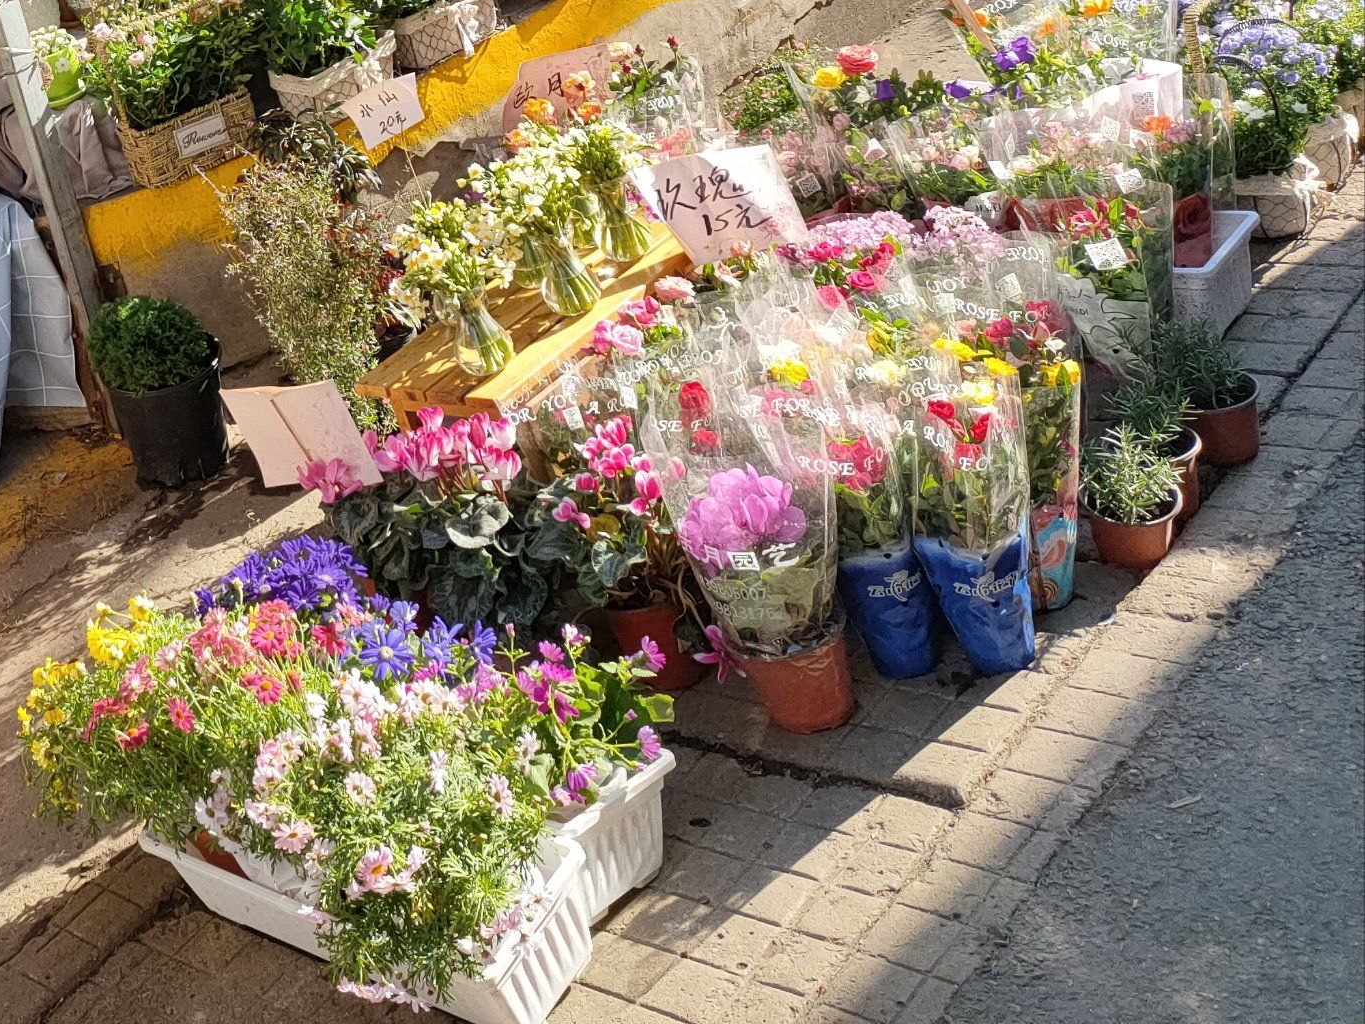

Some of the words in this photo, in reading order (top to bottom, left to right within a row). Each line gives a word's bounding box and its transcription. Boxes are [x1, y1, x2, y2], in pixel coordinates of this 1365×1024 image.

[360, 90, 399, 119] 水仙
[379, 112, 408, 134] 20元
[182, 126, 229, 149] Flowers
[656, 166, 753, 220] 玫瑰
[702, 203, 773, 236] 15元
[509, 406, 537, 426] OR
[798, 455, 856, 476] ROSE
